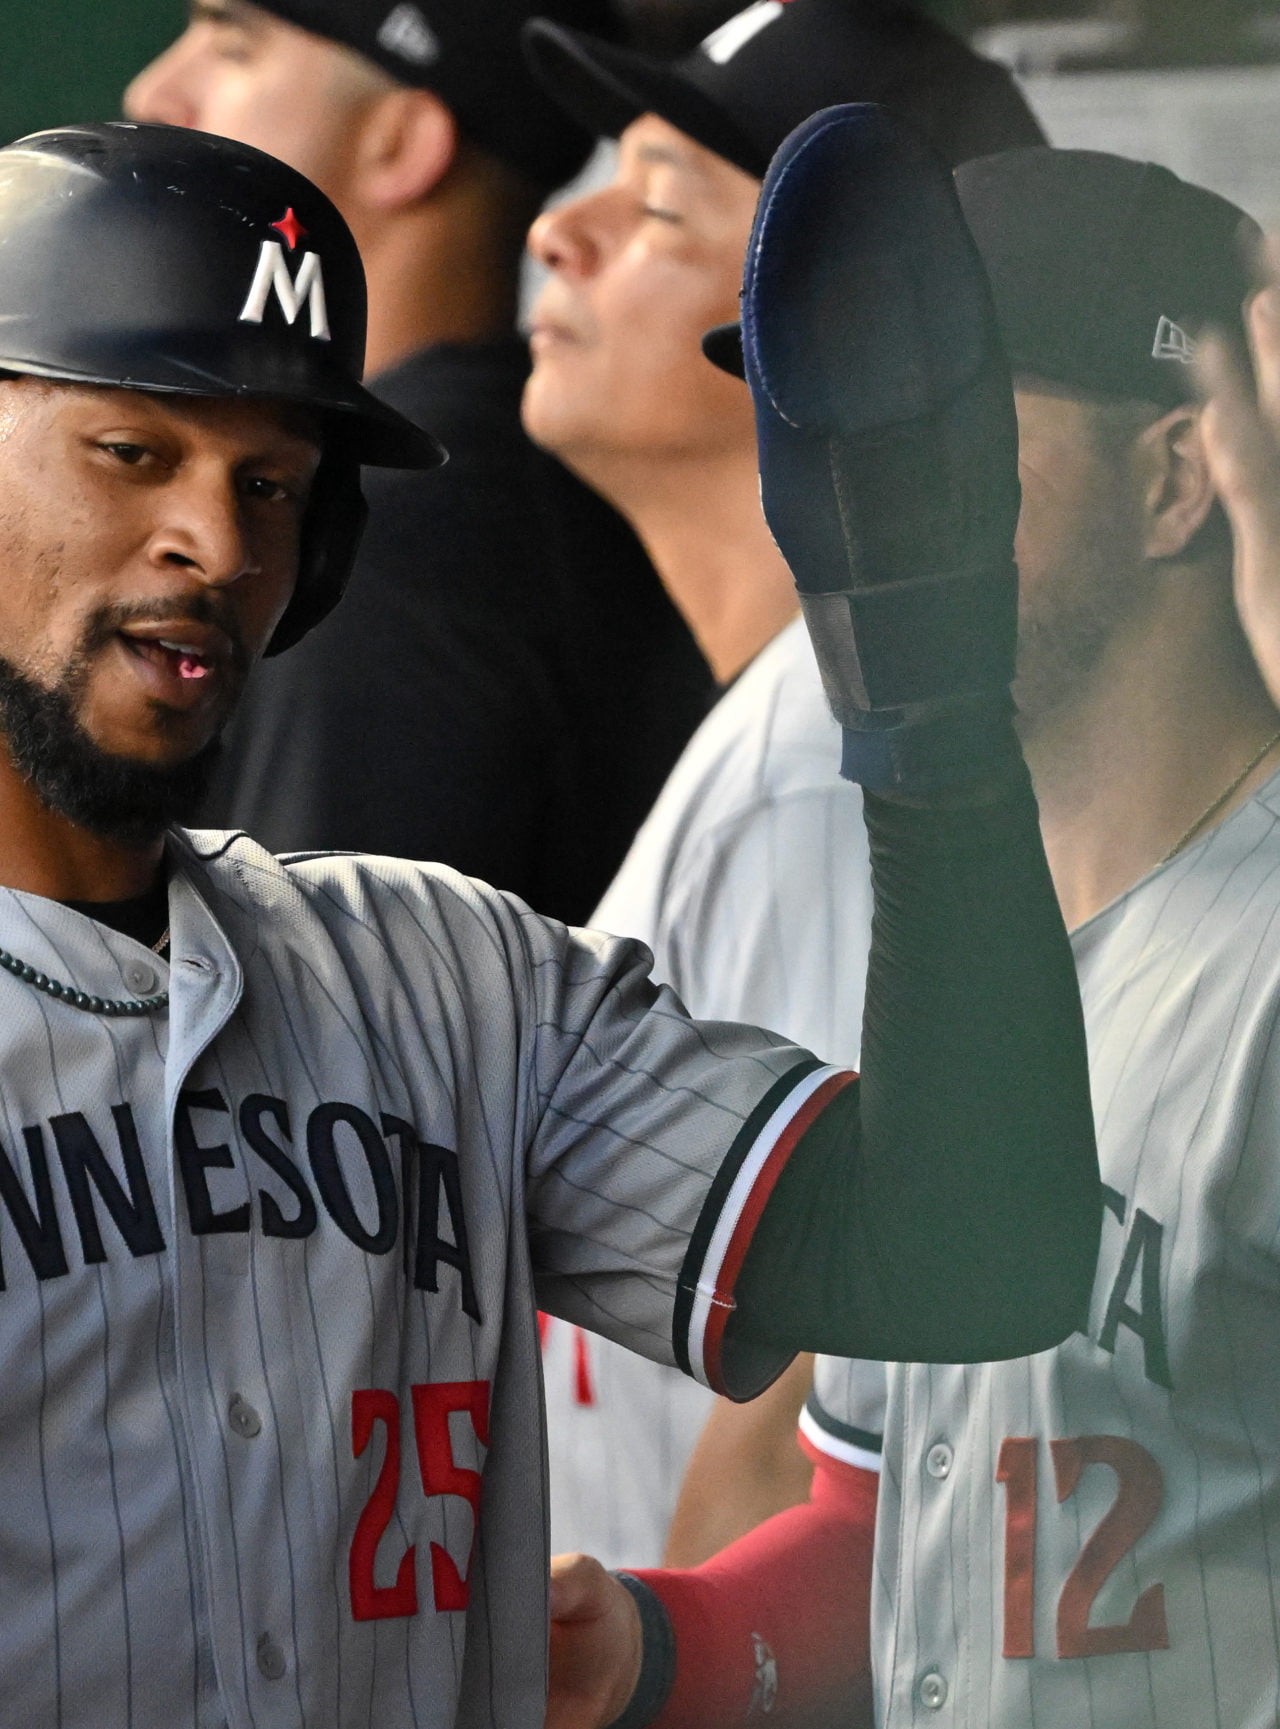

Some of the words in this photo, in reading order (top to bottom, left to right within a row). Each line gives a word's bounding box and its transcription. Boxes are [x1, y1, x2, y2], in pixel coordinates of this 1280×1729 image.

[239, 240, 332, 342] M
[348, 1380, 491, 1622] 25
[996, 1435, 1170, 1660] 12
